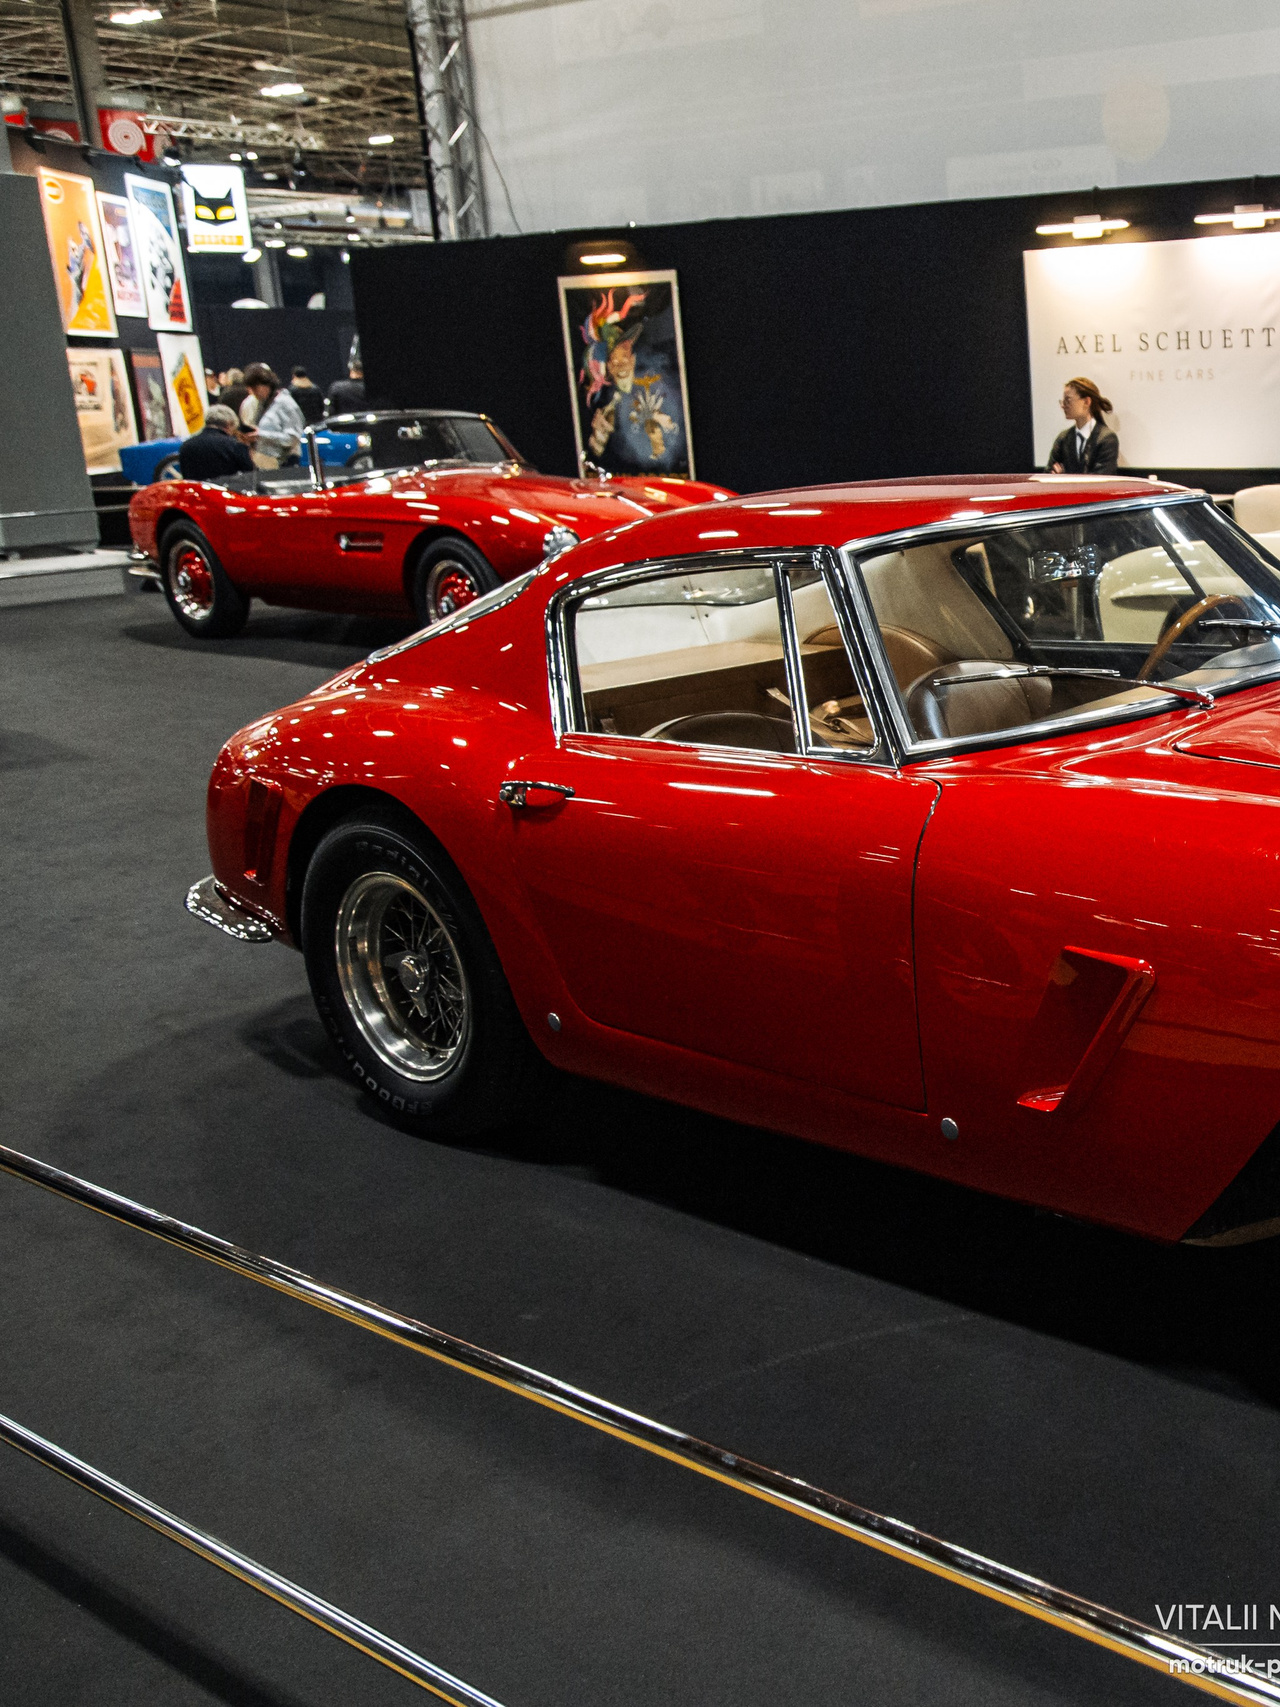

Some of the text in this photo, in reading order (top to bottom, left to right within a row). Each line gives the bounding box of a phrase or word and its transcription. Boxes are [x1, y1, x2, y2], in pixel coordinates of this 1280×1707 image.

[1056, 333, 1122, 354] AXEL
[1130, 367, 1215, 381] FINE CARS
